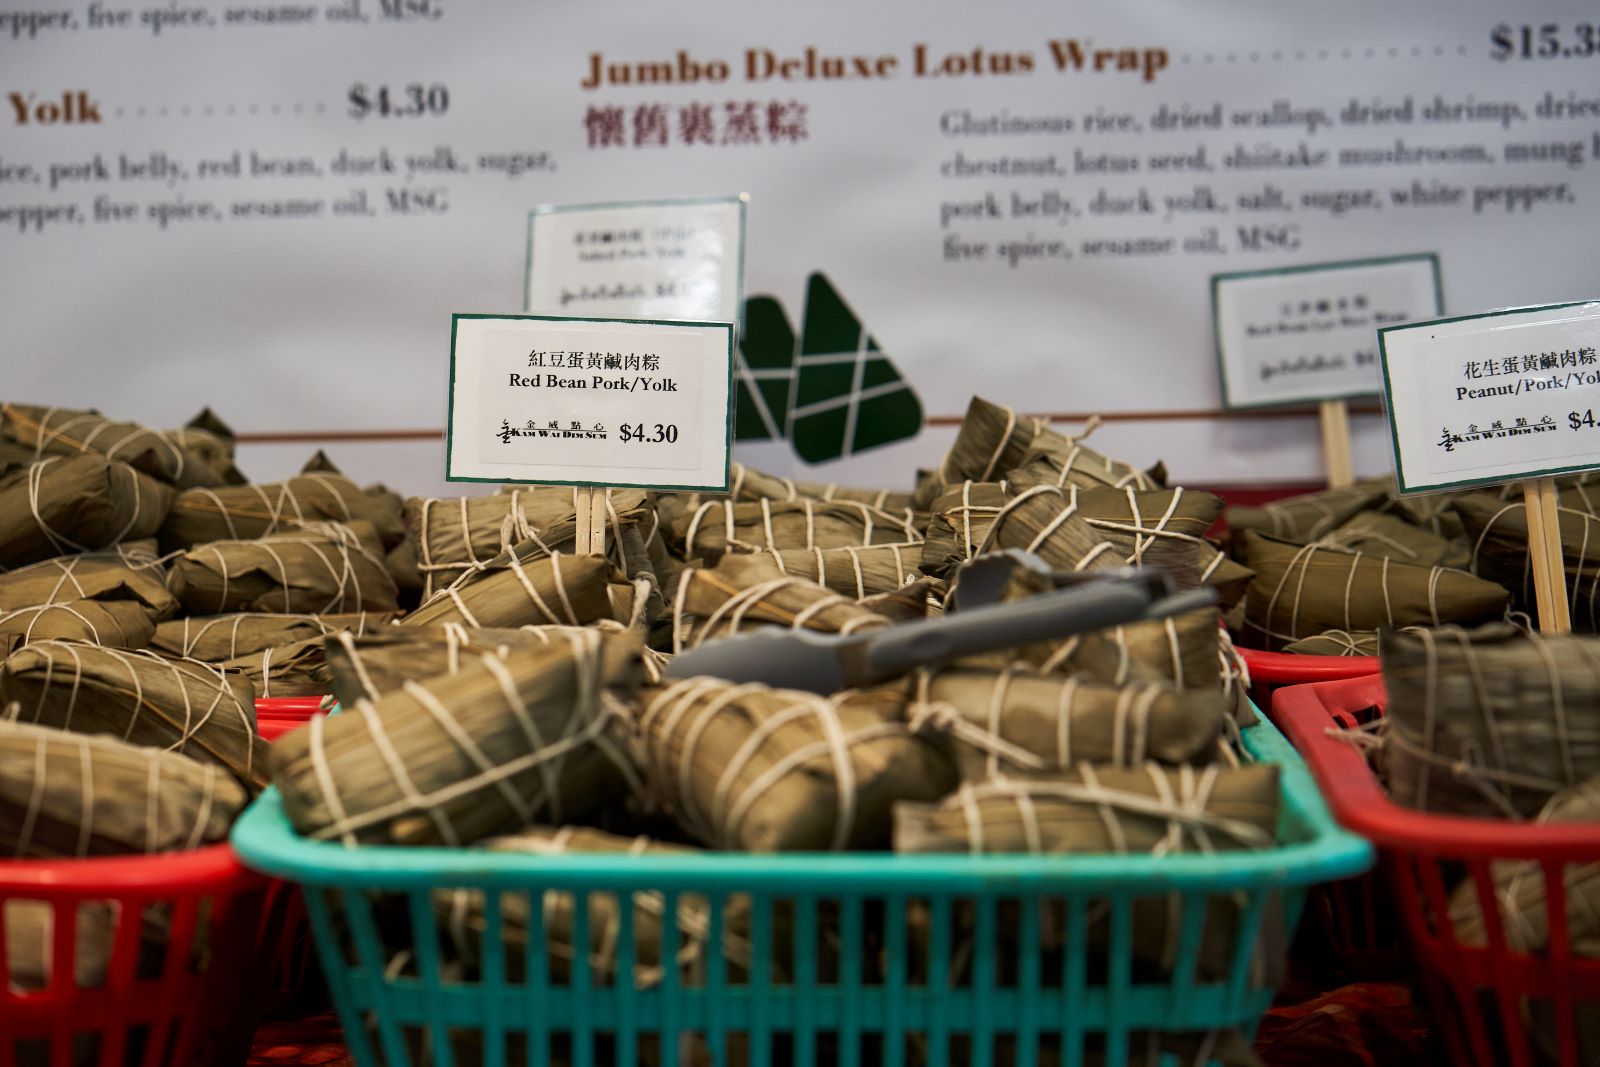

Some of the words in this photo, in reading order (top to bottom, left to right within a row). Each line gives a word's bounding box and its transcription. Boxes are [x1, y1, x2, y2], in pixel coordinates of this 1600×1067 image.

[88, 1, 131, 30] five
[225, 7, 317, 24] sesame
[380, 0, 442, 22] MSG
[581, 51, 730, 90] Jumbo
[744, 46, 897, 81] Deluxe
[913, 42, 1036, 77] Lotus
[1047, 37, 1170, 84] Wrap
[1489, 21, 1600, 63] $15.3
[7, 90, 103, 127] Yolk
[347, 81, 450, 121] $4.30
[939, 106, 1075, 137] Glutinous
[1150, 101, 1223, 131] dried
[1340, 97, 1414, 126] dried
[1422, 93, 1528, 130] shrimp,
[50, 151, 109, 191] pork
[198, 149, 242, 179] red
[330, 147, 396, 176] duck
[940, 149, 1067, 178] chestnut,
[1073, 146, 1140, 175] lotus
[1223, 140, 1328, 170] shiitake
[1337, 137, 1496, 167] mushroom,
[1503, 141, 1585, 171] mung
[93, 194, 140, 224] five
[230, 200, 324, 221] sesame
[385, 186, 450, 214] MSG
[940, 190, 1002, 229] pork
[1088, 187, 1153, 216] duck
[1390, 177, 1466, 207] white
[1472, 182, 1576, 214] pepper,
[943, 232, 990, 262] five
[1078, 237, 1176, 260] sesame
[1235, 223, 1302, 252] MSG
[528, 349, 661, 371] 紅豆蛋黃鹹肉粽
[1463, 346, 1598, 381] 花生蛋黃鹹肉粽
[508, 373, 542, 388] Red
[545, 374, 588, 389] Bean
[592, 375, 678, 393] Pork/Yolk
[619, 422, 679, 444] $4.30
